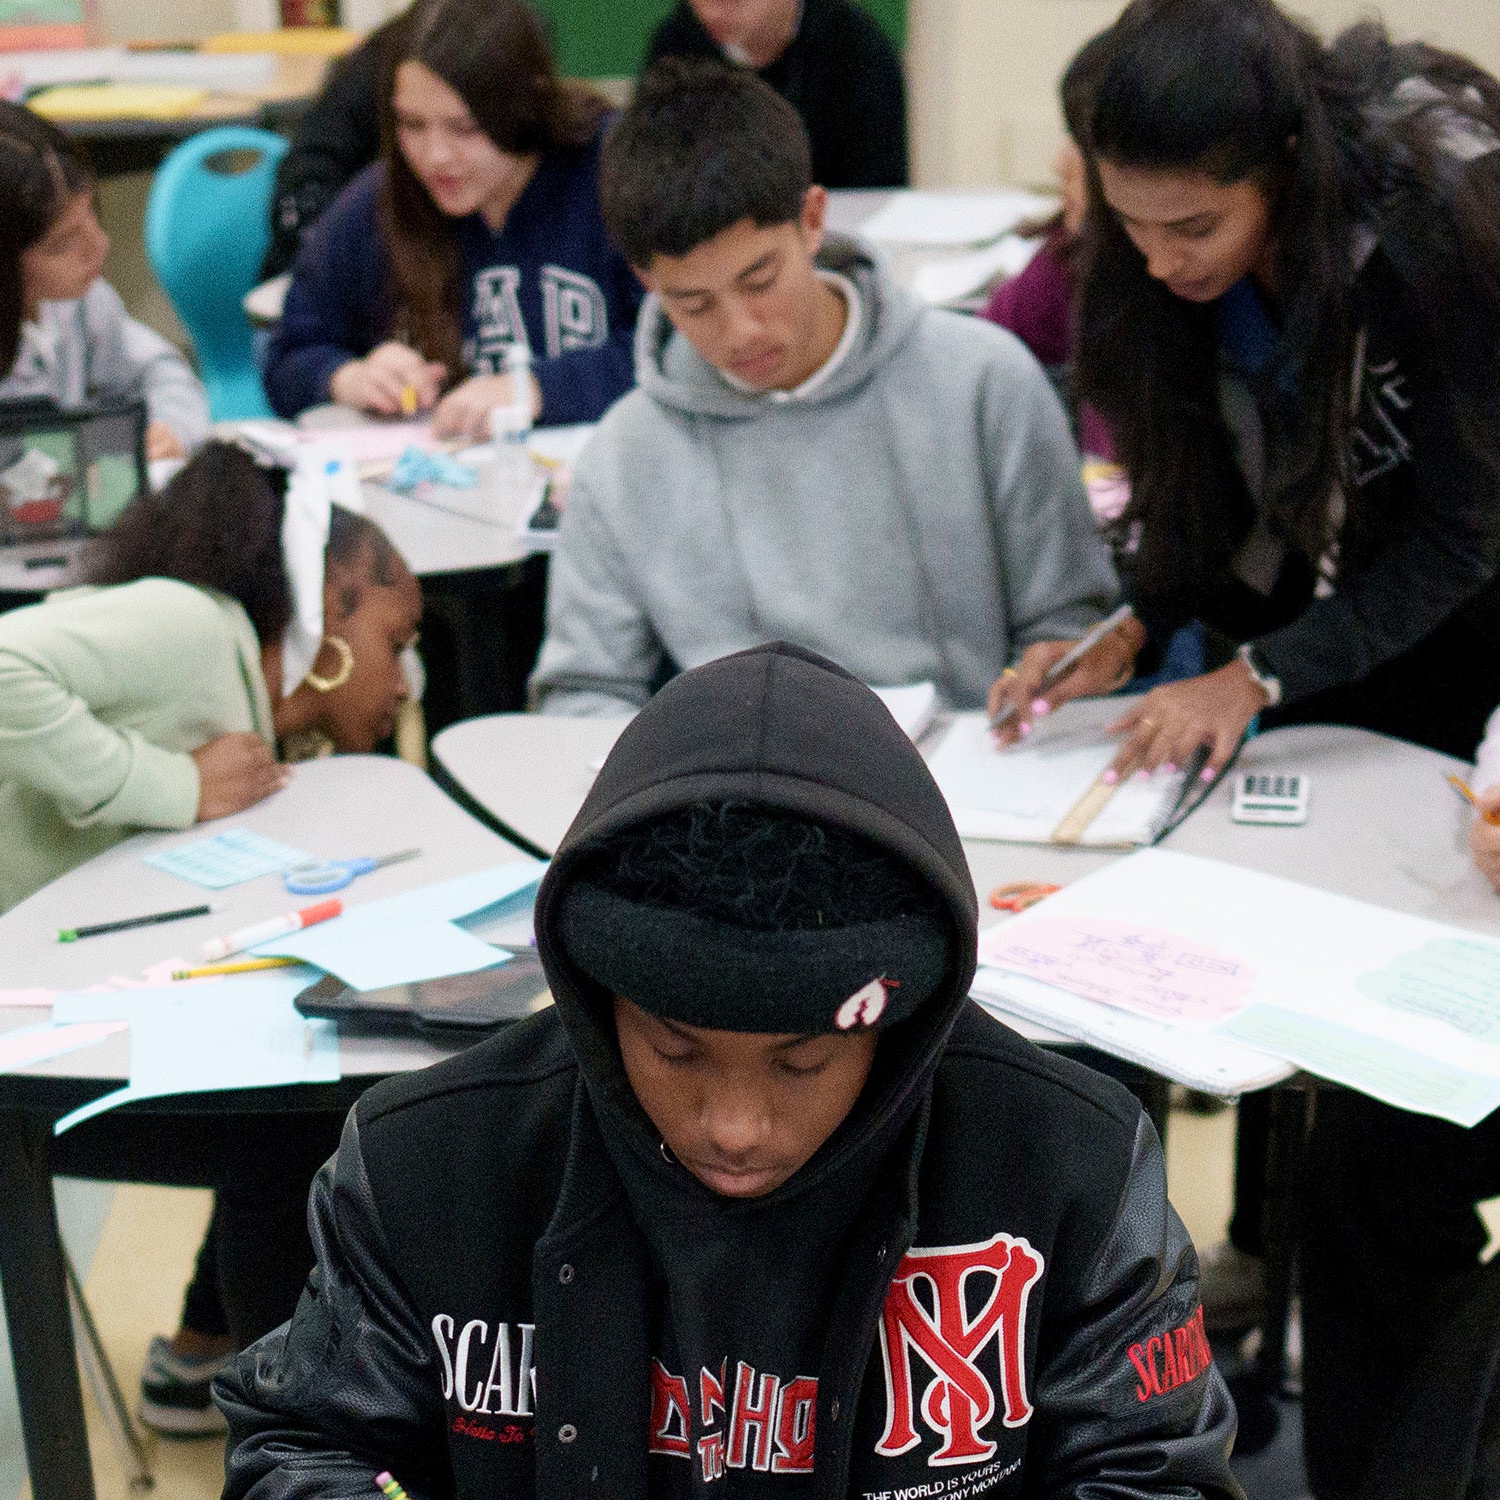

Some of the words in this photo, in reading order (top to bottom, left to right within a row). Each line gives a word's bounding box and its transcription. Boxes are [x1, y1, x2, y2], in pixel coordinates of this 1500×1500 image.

[947, 1476, 959, 1492] IS
[960, 1460, 1002, 1486] YOURS
[971, 1457, 1023, 1497] MONTANA
